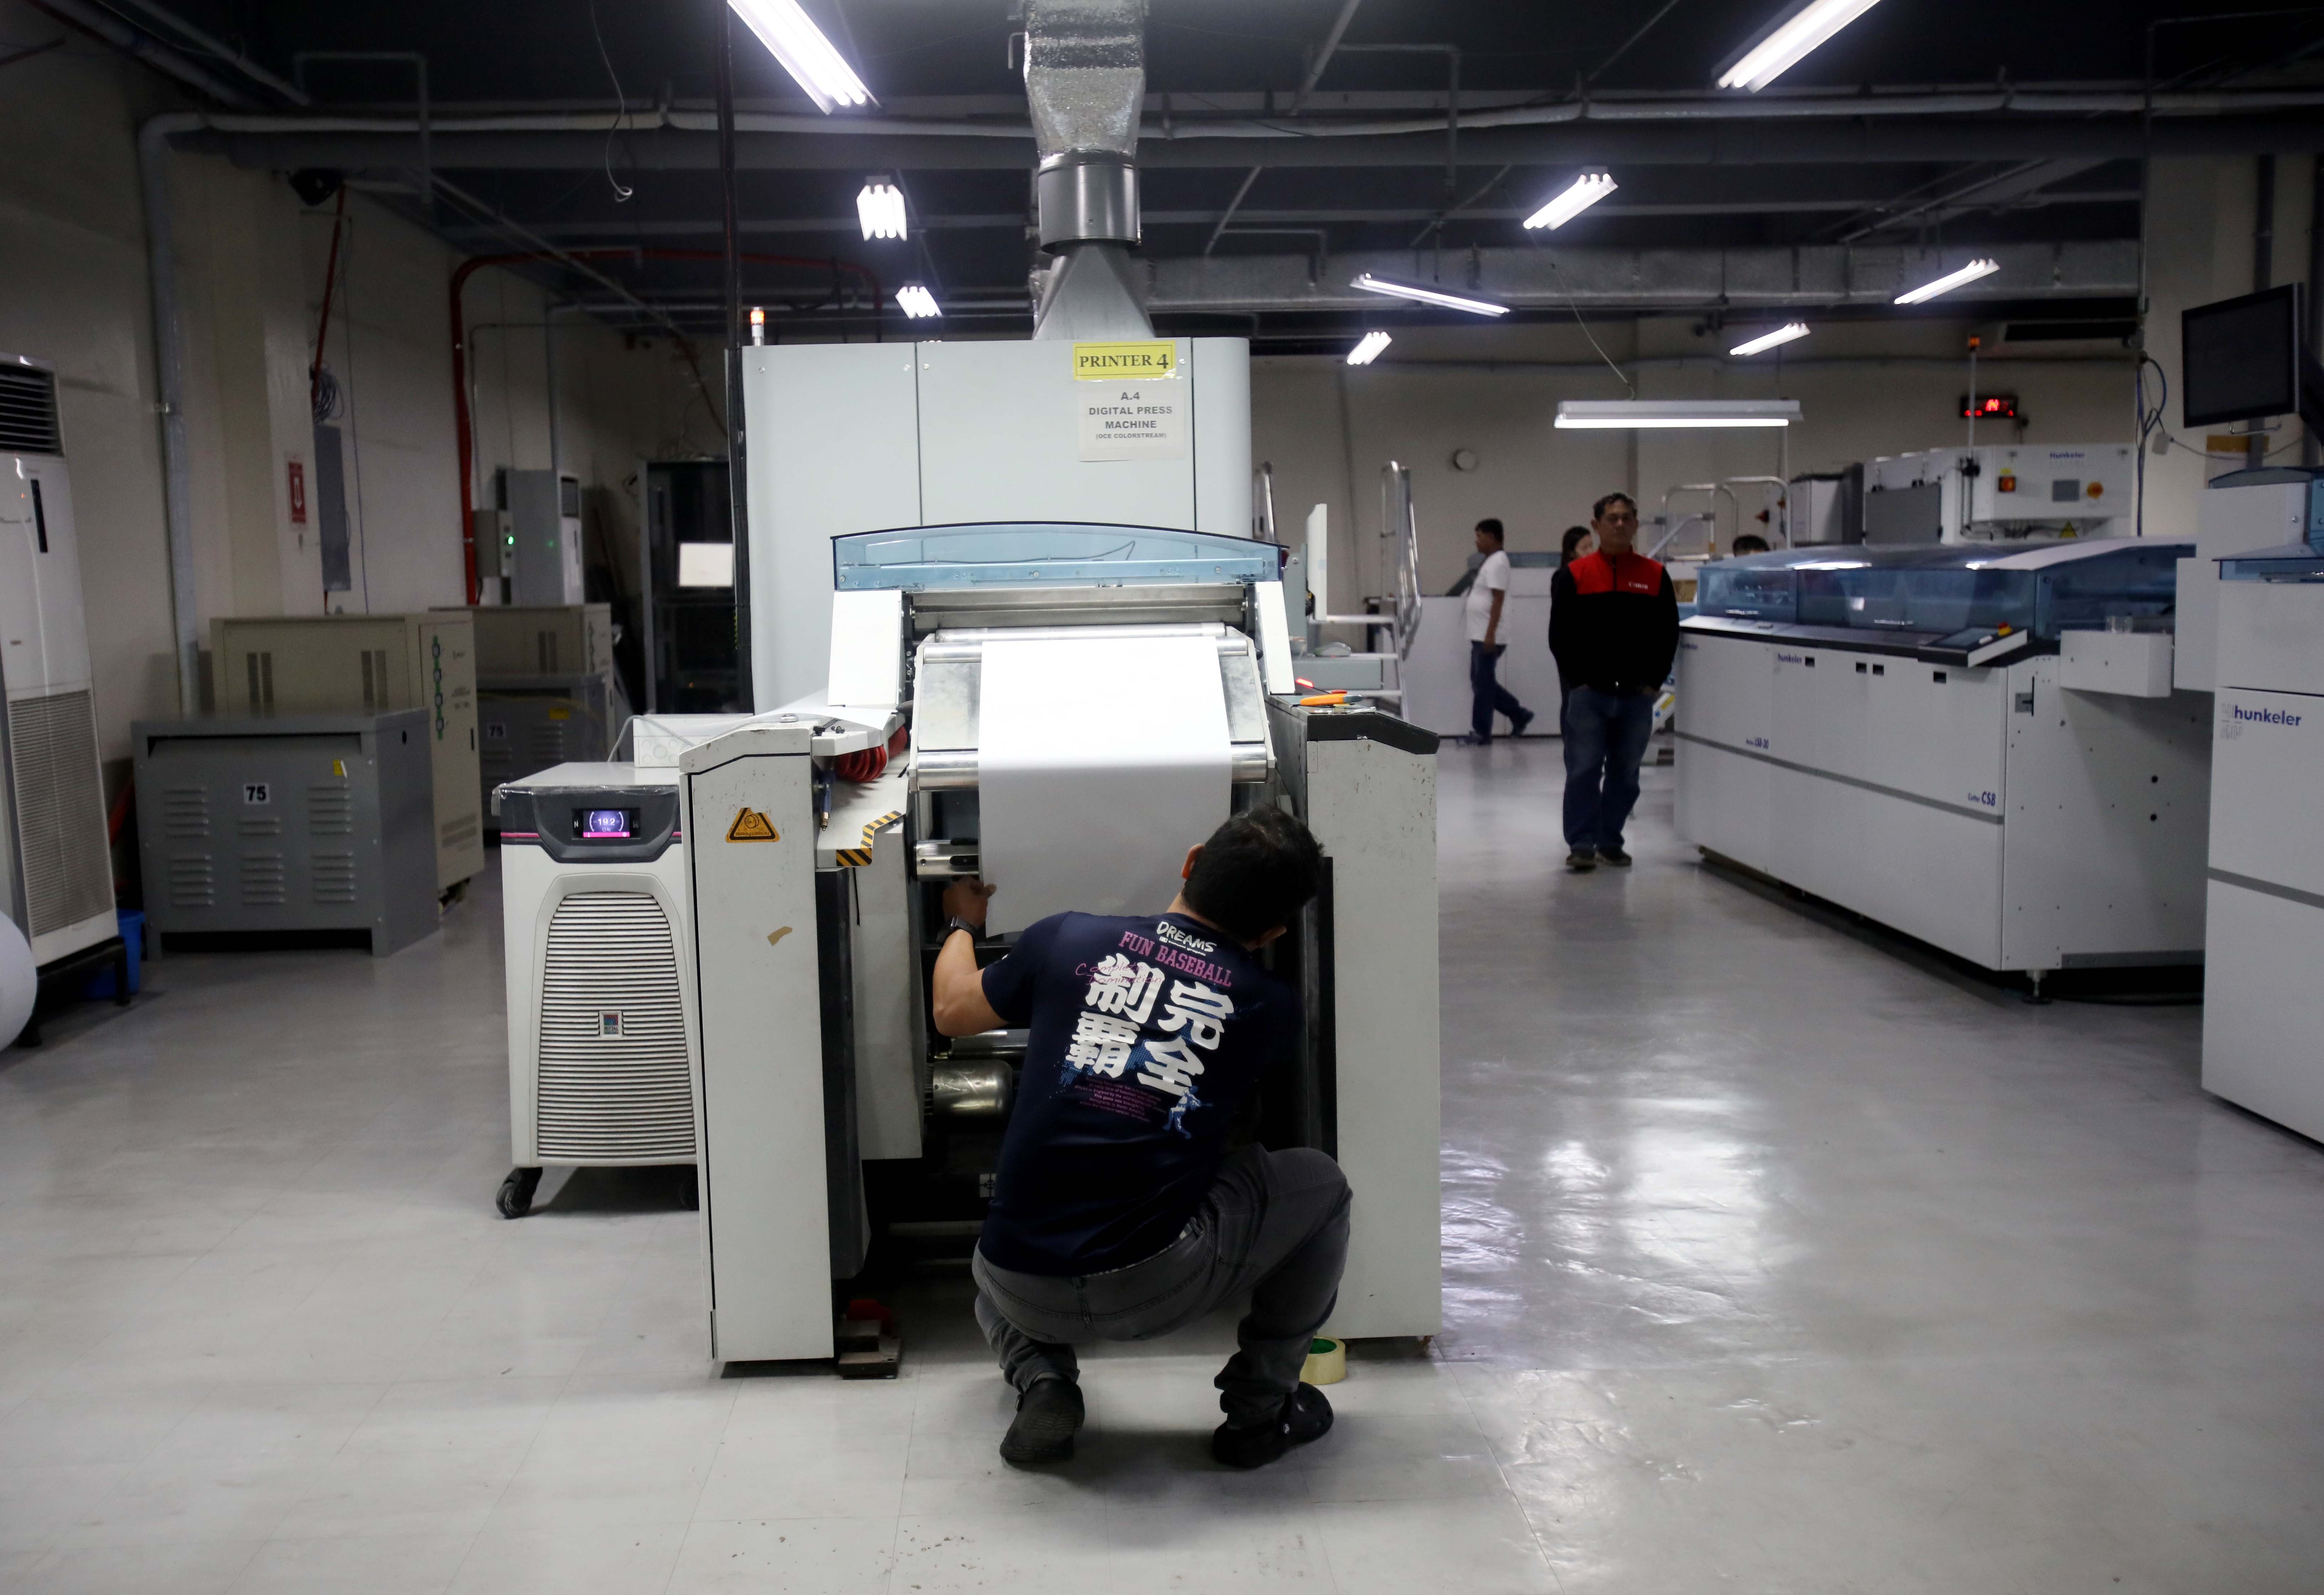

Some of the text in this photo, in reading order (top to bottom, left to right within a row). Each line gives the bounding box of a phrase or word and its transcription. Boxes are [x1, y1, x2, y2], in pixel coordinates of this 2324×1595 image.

[1079, 354, 1169, 369] PRINTER 4
[1121, 392, 1140, 400] A.4
[1089, 407, 1133, 415] DIGITAL
[1105, 420, 1157, 429] MACHINE
[2234, 704, 2302, 726] hunkeler
[246, 785, 267, 802] 75
[598, 818, 615, 826] 19.2
[1156, 921, 1217, 952] DREAMS
[1118, 931, 1233, 988] FUN BASEBALL
[1075, 962, 1143, 976] Complete
